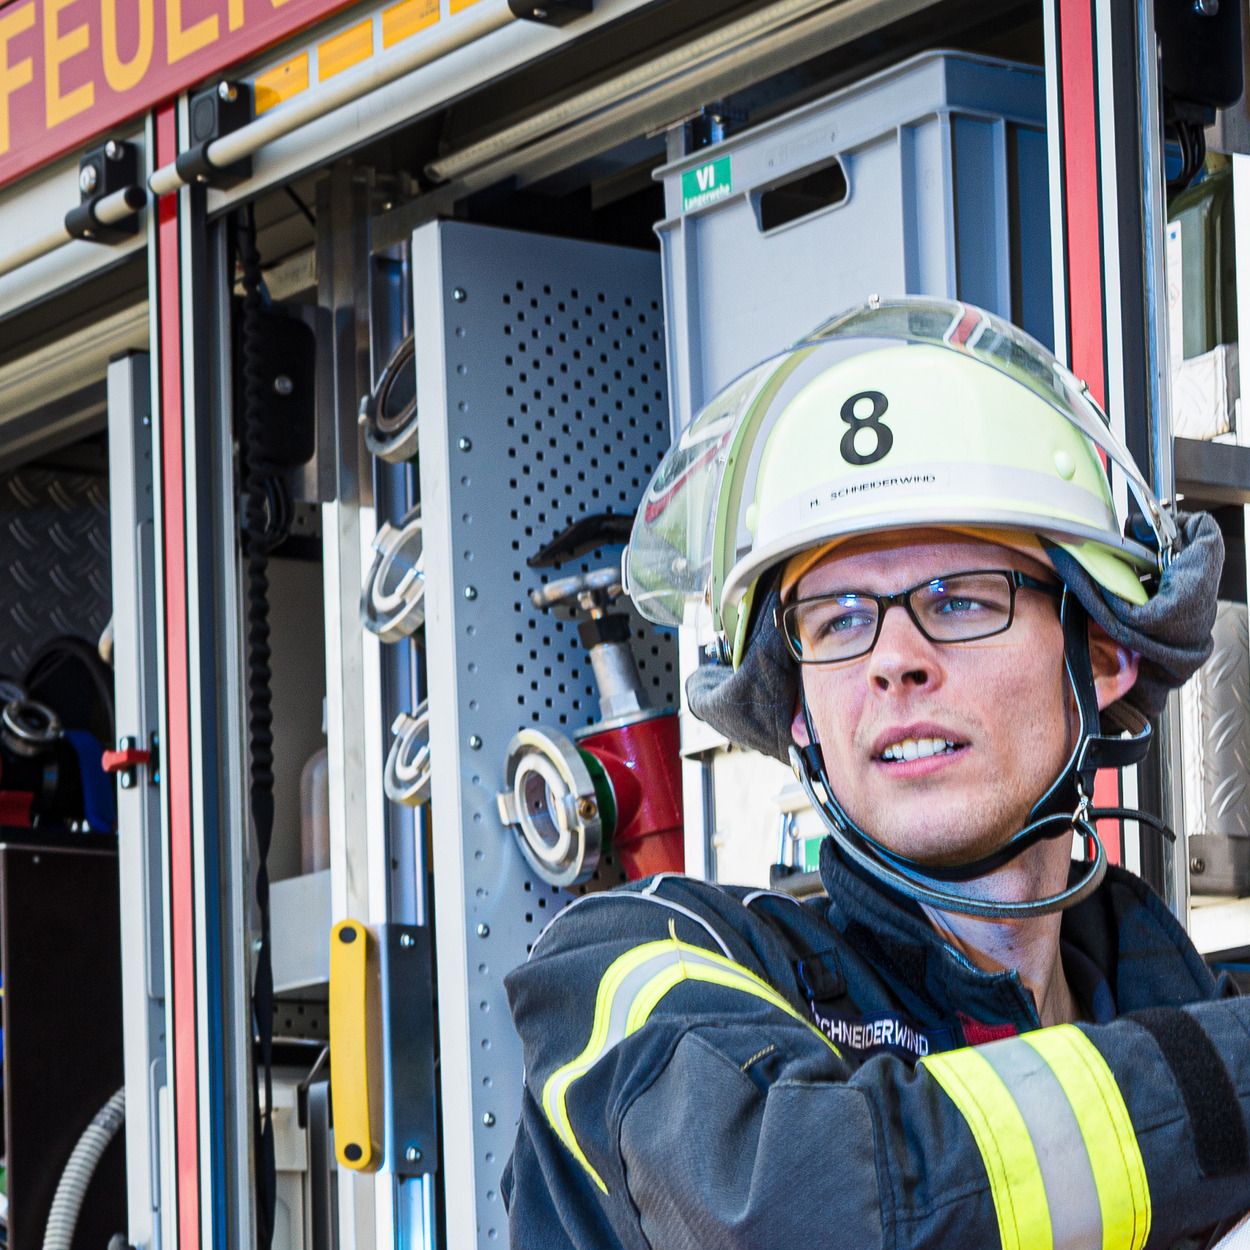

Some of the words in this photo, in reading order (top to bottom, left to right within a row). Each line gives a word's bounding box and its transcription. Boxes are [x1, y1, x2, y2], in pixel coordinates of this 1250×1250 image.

[696, 165, 715, 191] VI
[840, 391, 893, 466] 8
[830, 473, 935, 500] SCHNEIDERWIND
